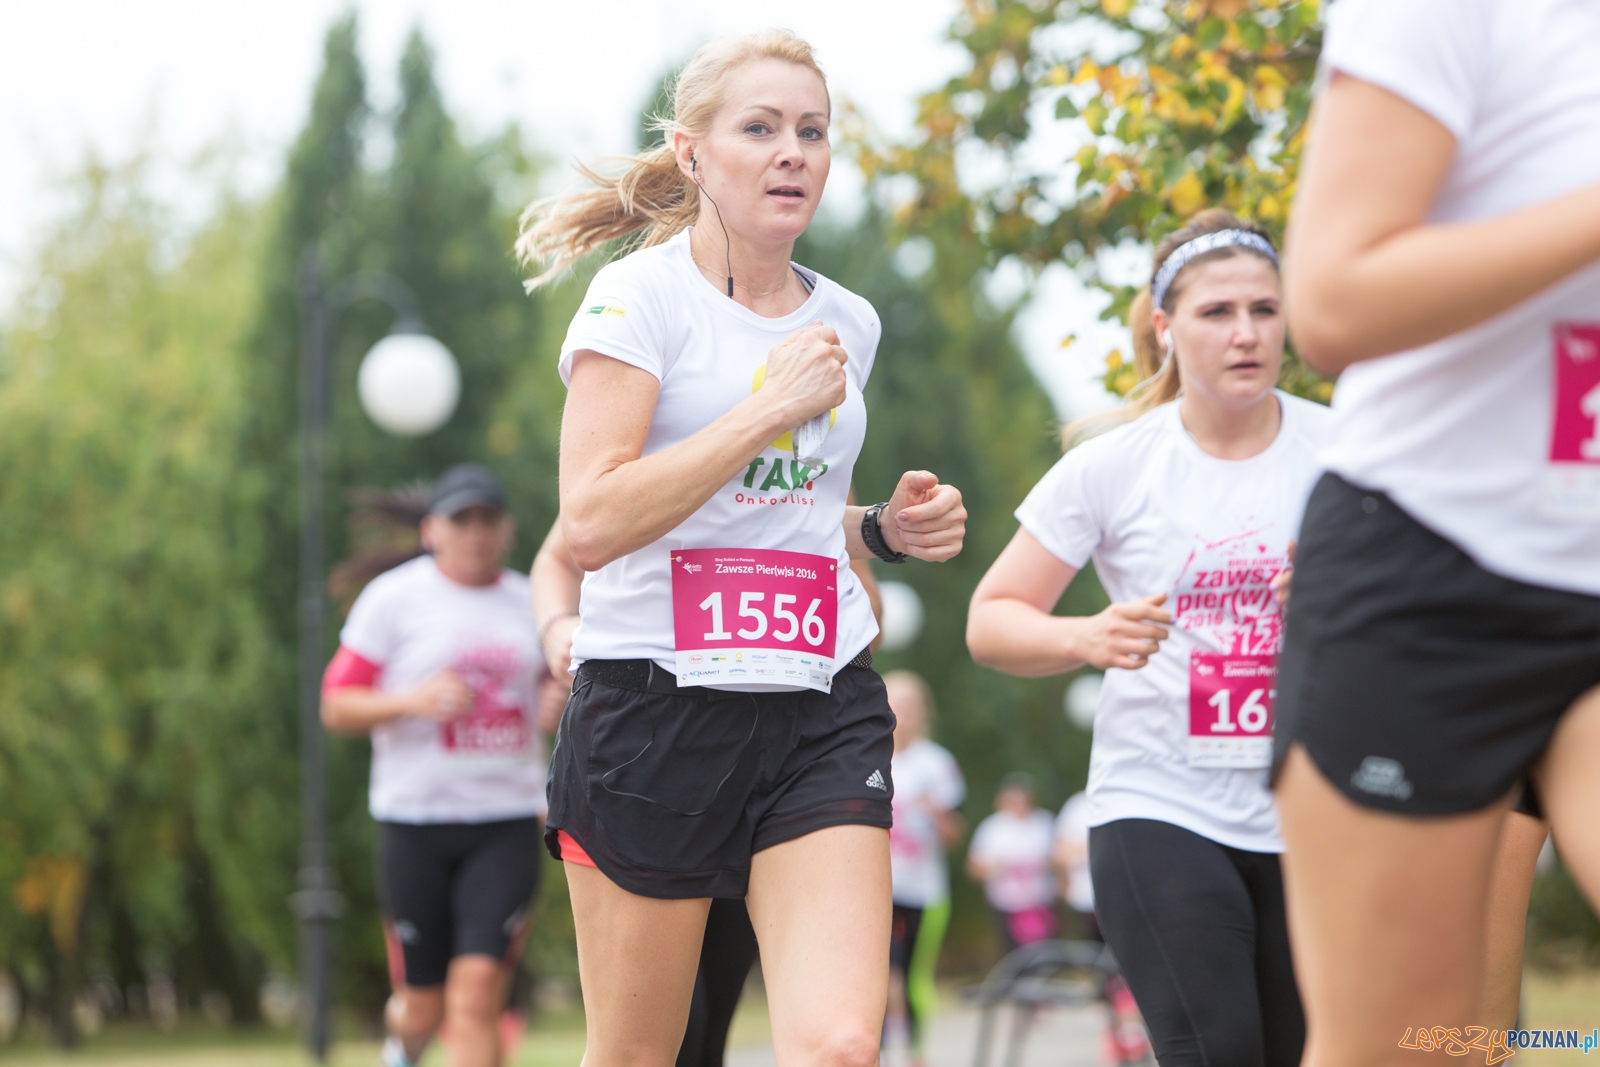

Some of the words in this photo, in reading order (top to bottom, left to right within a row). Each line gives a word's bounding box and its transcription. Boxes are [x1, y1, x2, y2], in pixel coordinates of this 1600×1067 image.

[715, 563, 754, 574] Zawsze
[756, 564, 794, 577] Pier(w)si
[796, 568, 817, 580] 2016
[699, 591, 826, 646] 1556
[1184, 611, 1224, 631] 2016
